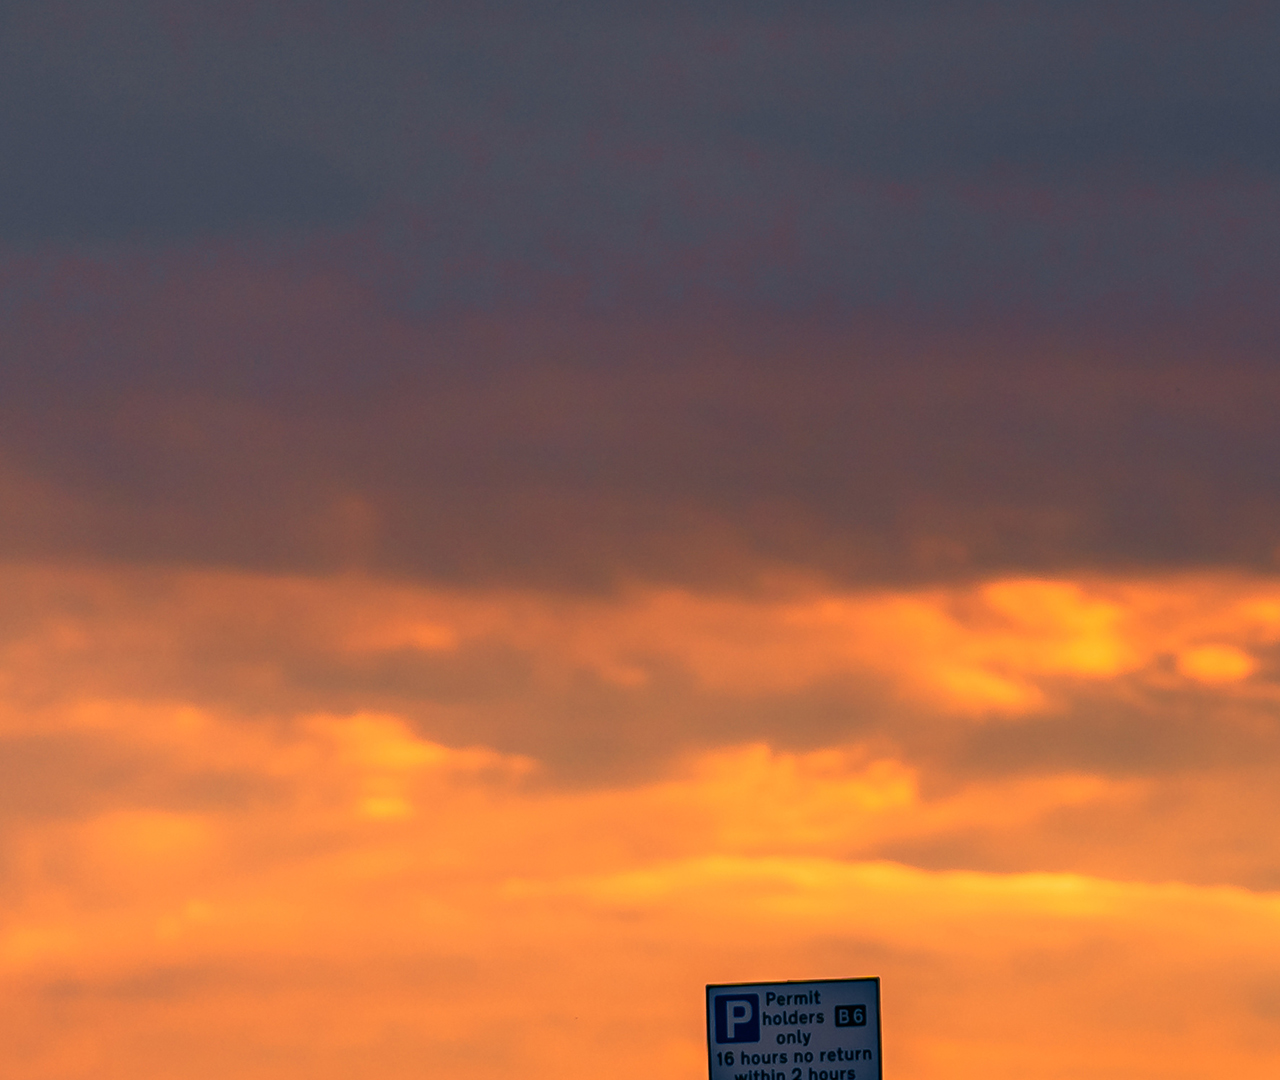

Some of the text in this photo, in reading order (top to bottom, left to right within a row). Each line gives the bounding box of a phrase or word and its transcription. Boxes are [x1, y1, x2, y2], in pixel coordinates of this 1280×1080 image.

[765, 990, 821, 1006] Permit
[726, 1000, 753, 1039] P
[762, 1010, 825, 1026] holders
[838, 1008, 864, 1024] B6
[776, 1029, 812, 1047] only
[717, 1047, 872, 1066] 16 hours no return
